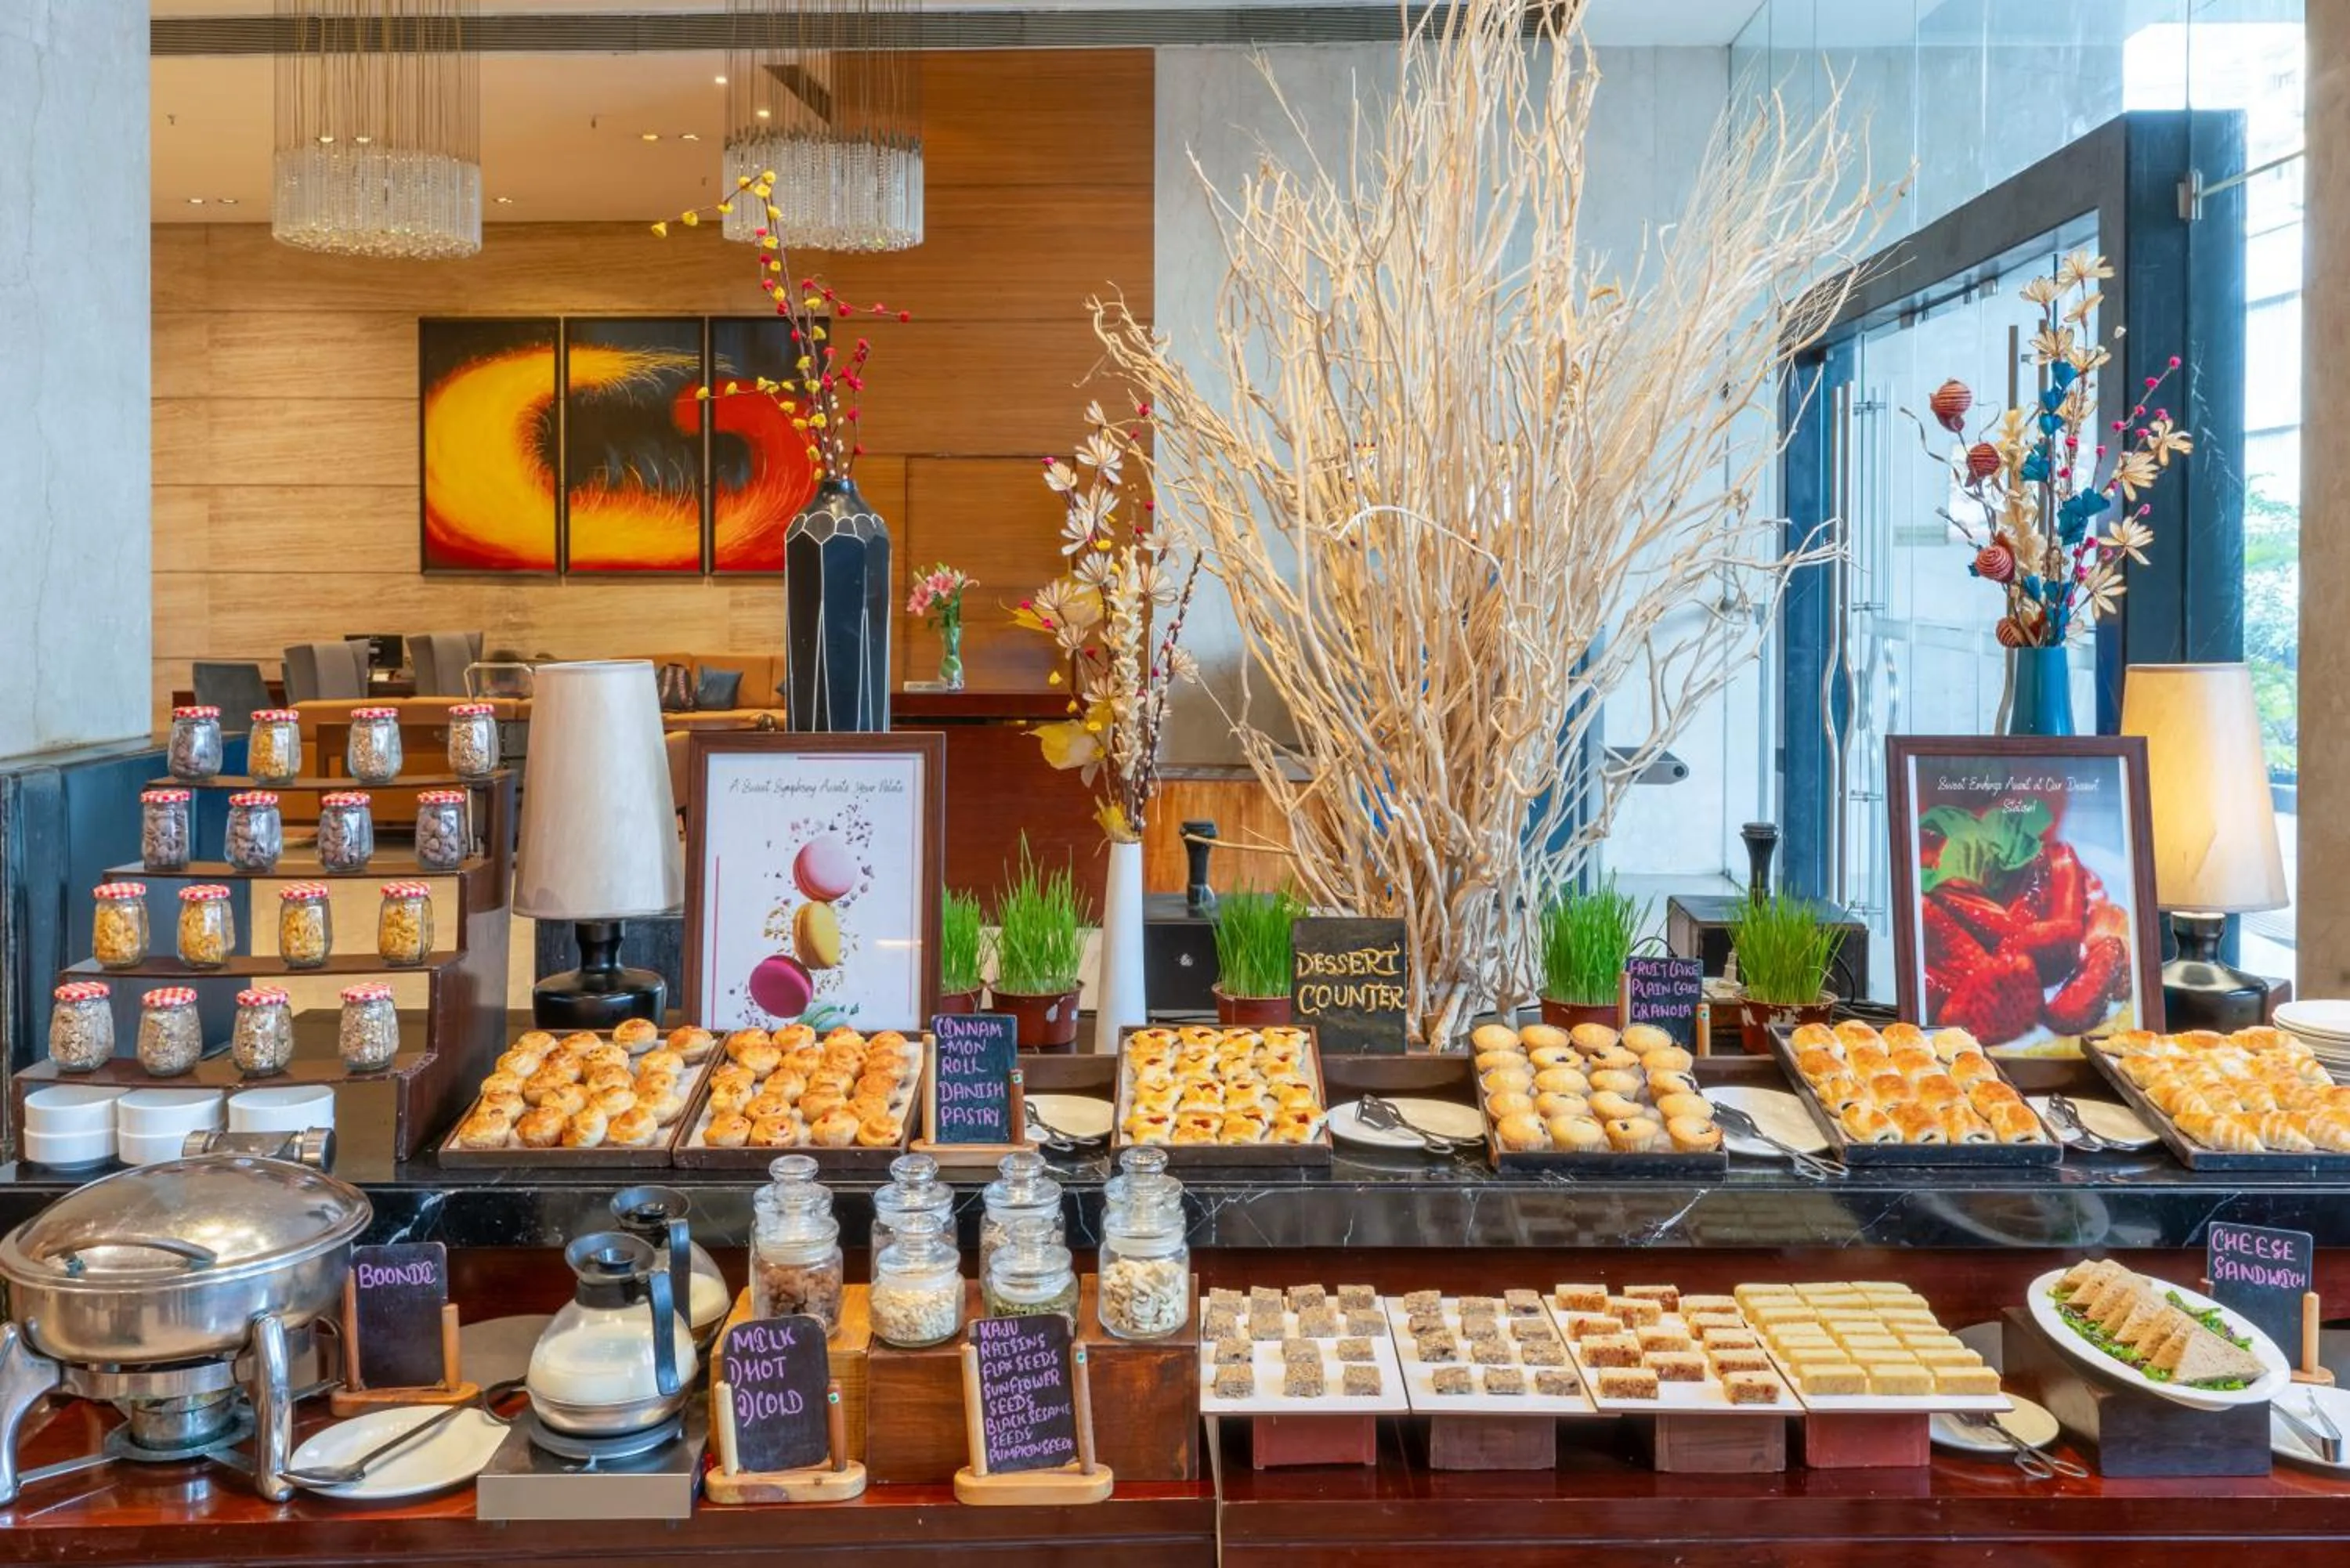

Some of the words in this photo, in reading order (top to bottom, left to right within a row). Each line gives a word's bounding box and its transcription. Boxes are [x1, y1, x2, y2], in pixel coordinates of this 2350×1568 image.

[728, 778, 739, 793] A
[2045, 776, 2063, 793] Our
[1296, 941, 1402, 979] DESSERT
[1629, 958, 1668, 978] FRUIT
[1669, 960, 1700, 978] CAKE
[1297, 981, 1407, 1016] COUNTER
[1632, 978, 1672, 999] PLAIN
[1674, 981, 1700, 996] CAKE
[1632, 1002, 1692, 1021] GRANOLA
[938, 1081, 1005, 1103] DANISH
[940, 1105, 1001, 1127] PASTRY
[2211, 1227, 2297, 1262] CHEESE
[358, 1260, 436, 1289] BOONDI
[2214, 1255, 2306, 1288] SANDWICH
[732, 1326, 797, 1353] MILK
[980, 1321, 1019, 1340] KAJU
[980, 1332, 1046, 1360] RAISINS
[1015, 1349, 1058, 1371] SEEDS
[983, 1367, 1061, 1400] SUNFLOWER
[989, 1394, 1036, 1416] SEEDS
[985, 1414, 1028, 1436] BLACK
[1028, 1403, 1071, 1425] SESAME
[992, 1426, 1033, 1449] SEEDS
